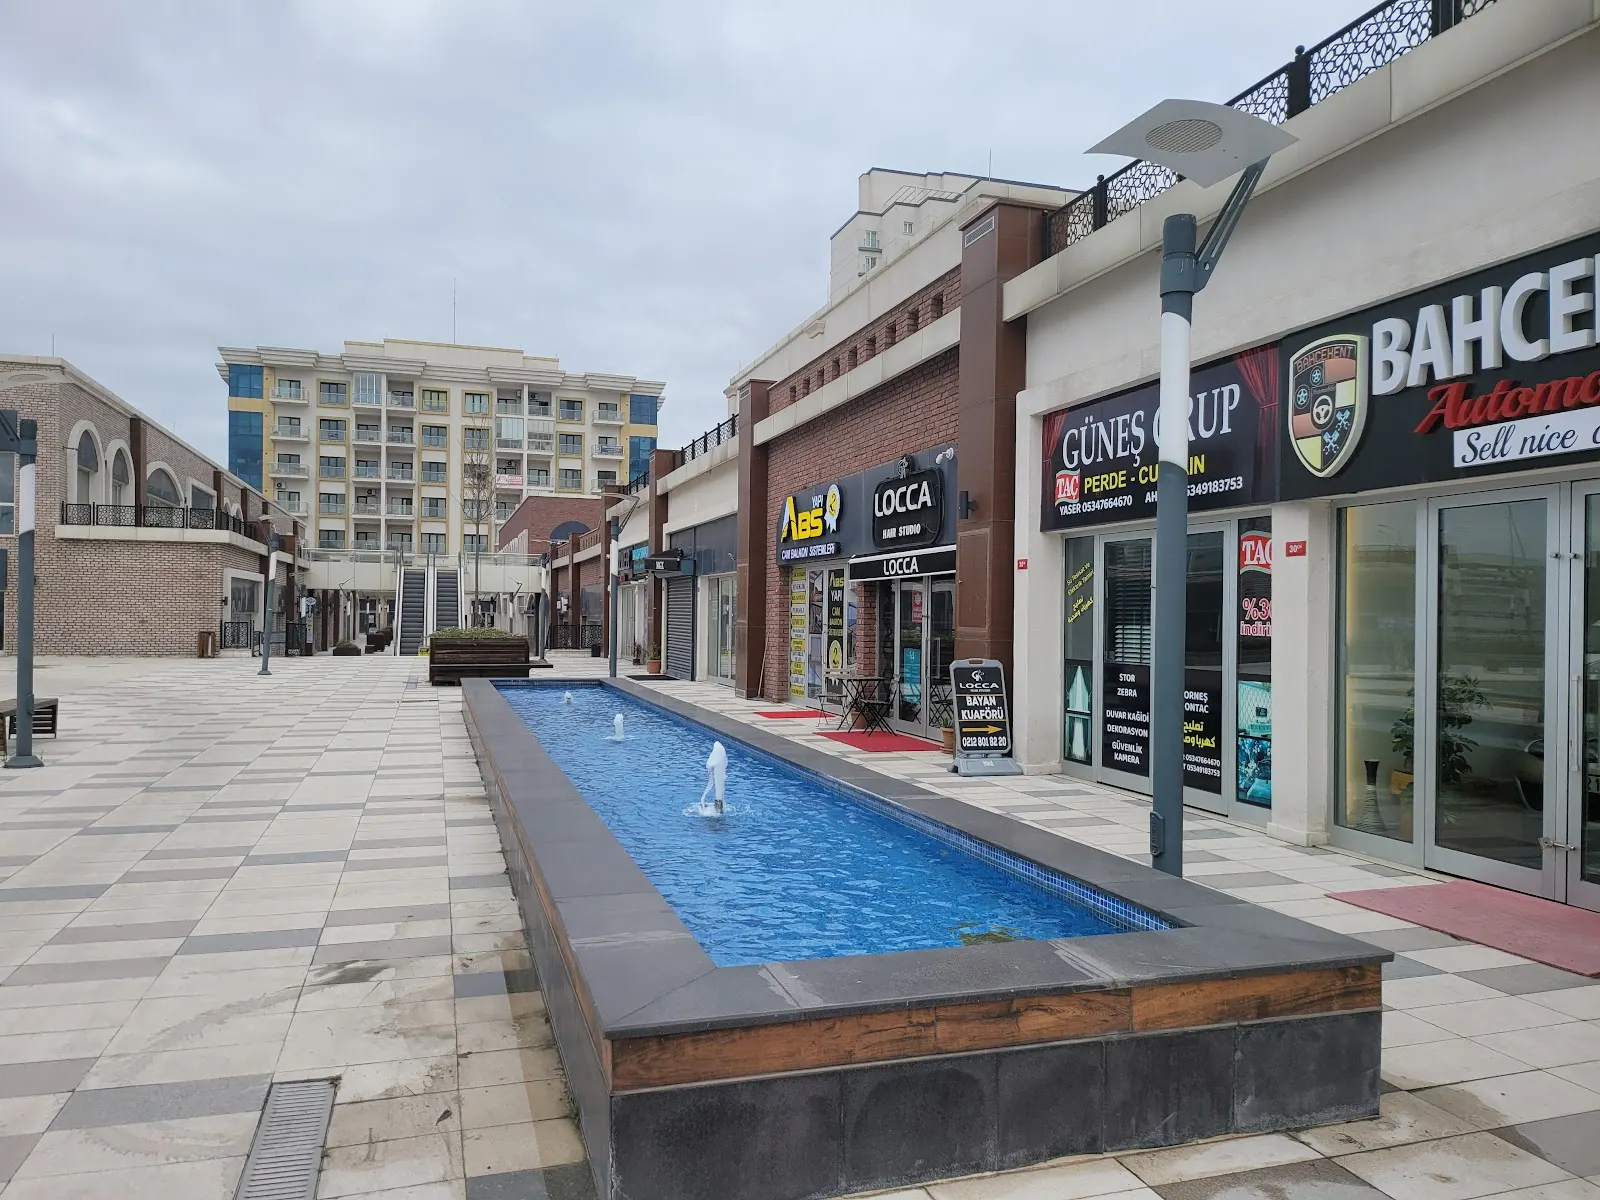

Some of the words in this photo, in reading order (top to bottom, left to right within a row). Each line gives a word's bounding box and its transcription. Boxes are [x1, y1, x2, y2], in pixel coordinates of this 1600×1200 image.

[1372, 253, 1600, 396] BAHCE
[1062, 409, 1145, 469] GÜNEŞ
[1153, 383, 1241, 448] UP
[1461, 423, 1516, 464] Sell
[1518, 425, 1579, 455] nice
[1056, 475, 1080, 500] TAÇ
[1084, 470, 1127, 494] PERDE
[874, 480, 932, 517] LOCCA
[1060, 503, 1081, 516] YASER
[882, 527, 897, 540] HAIR
[898, 523, 921, 537] STUDIO
[883, 556, 919, 575] LOCCA
[1240, 620, 1272, 637] indiri
[1119, 673, 1136, 683] STOR
[1117, 687, 1138, 698] ZEBRA
[966, 696, 997, 707] BAYAN
[961, 707, 1004, 720] KUAFÖRÜ
[1106, 709, 1127, 720] DUVAR
[1107, 723, 1149, 738] DEKORASYON
[1111, 739, 1143, 754] GÜVENLİK
[1113, 751, 1141, 765] KAMERA
